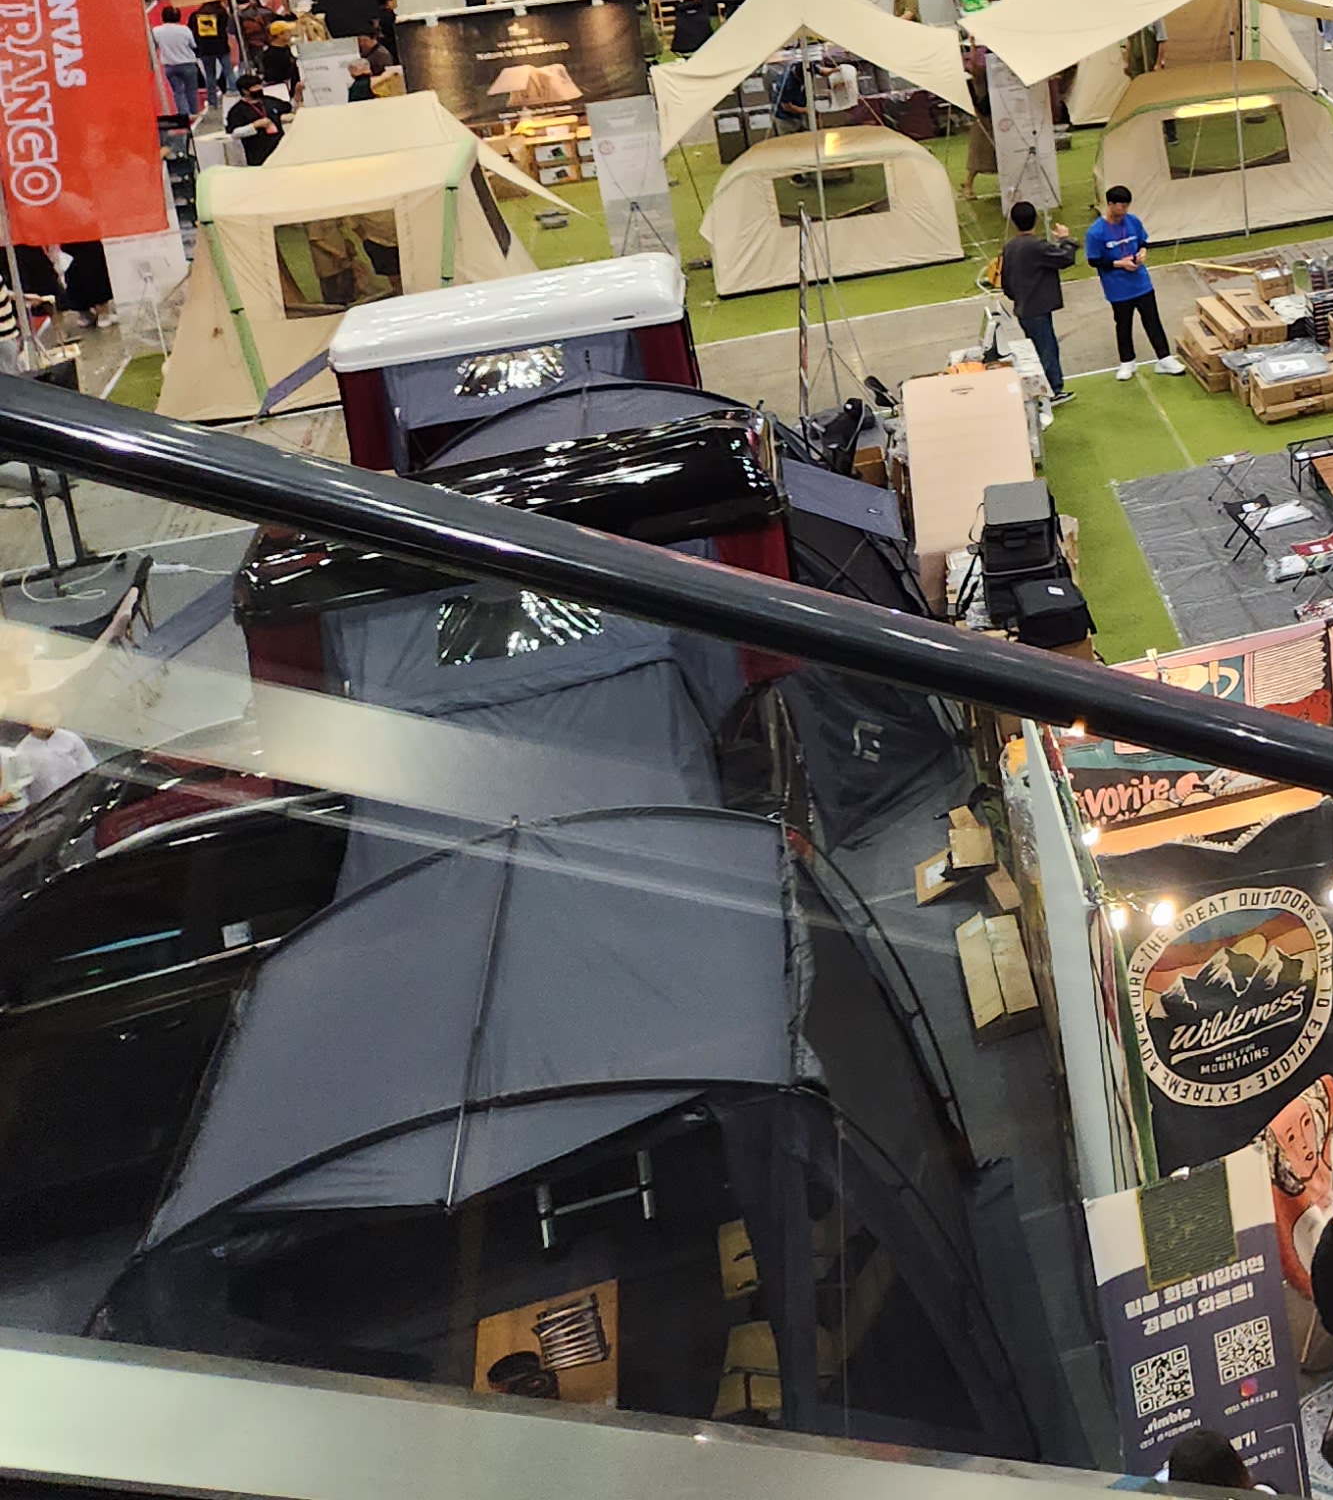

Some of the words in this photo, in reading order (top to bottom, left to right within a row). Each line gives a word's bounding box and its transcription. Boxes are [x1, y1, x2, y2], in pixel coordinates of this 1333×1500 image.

[1141, 929, 1170, 960] THE
[1172, 895, 1229, 932] GREAT
[1238, 890, 1318, 922] OUTDOORS
[1171, 985, 1306, 1051] Wilderness
[1200, 1045, 1269, 1075] MOUNTAINS
[1266, 1019, 1324, 1082] EXPLORE
[1163, 1255, 1265, 1305] 회원가입하면
